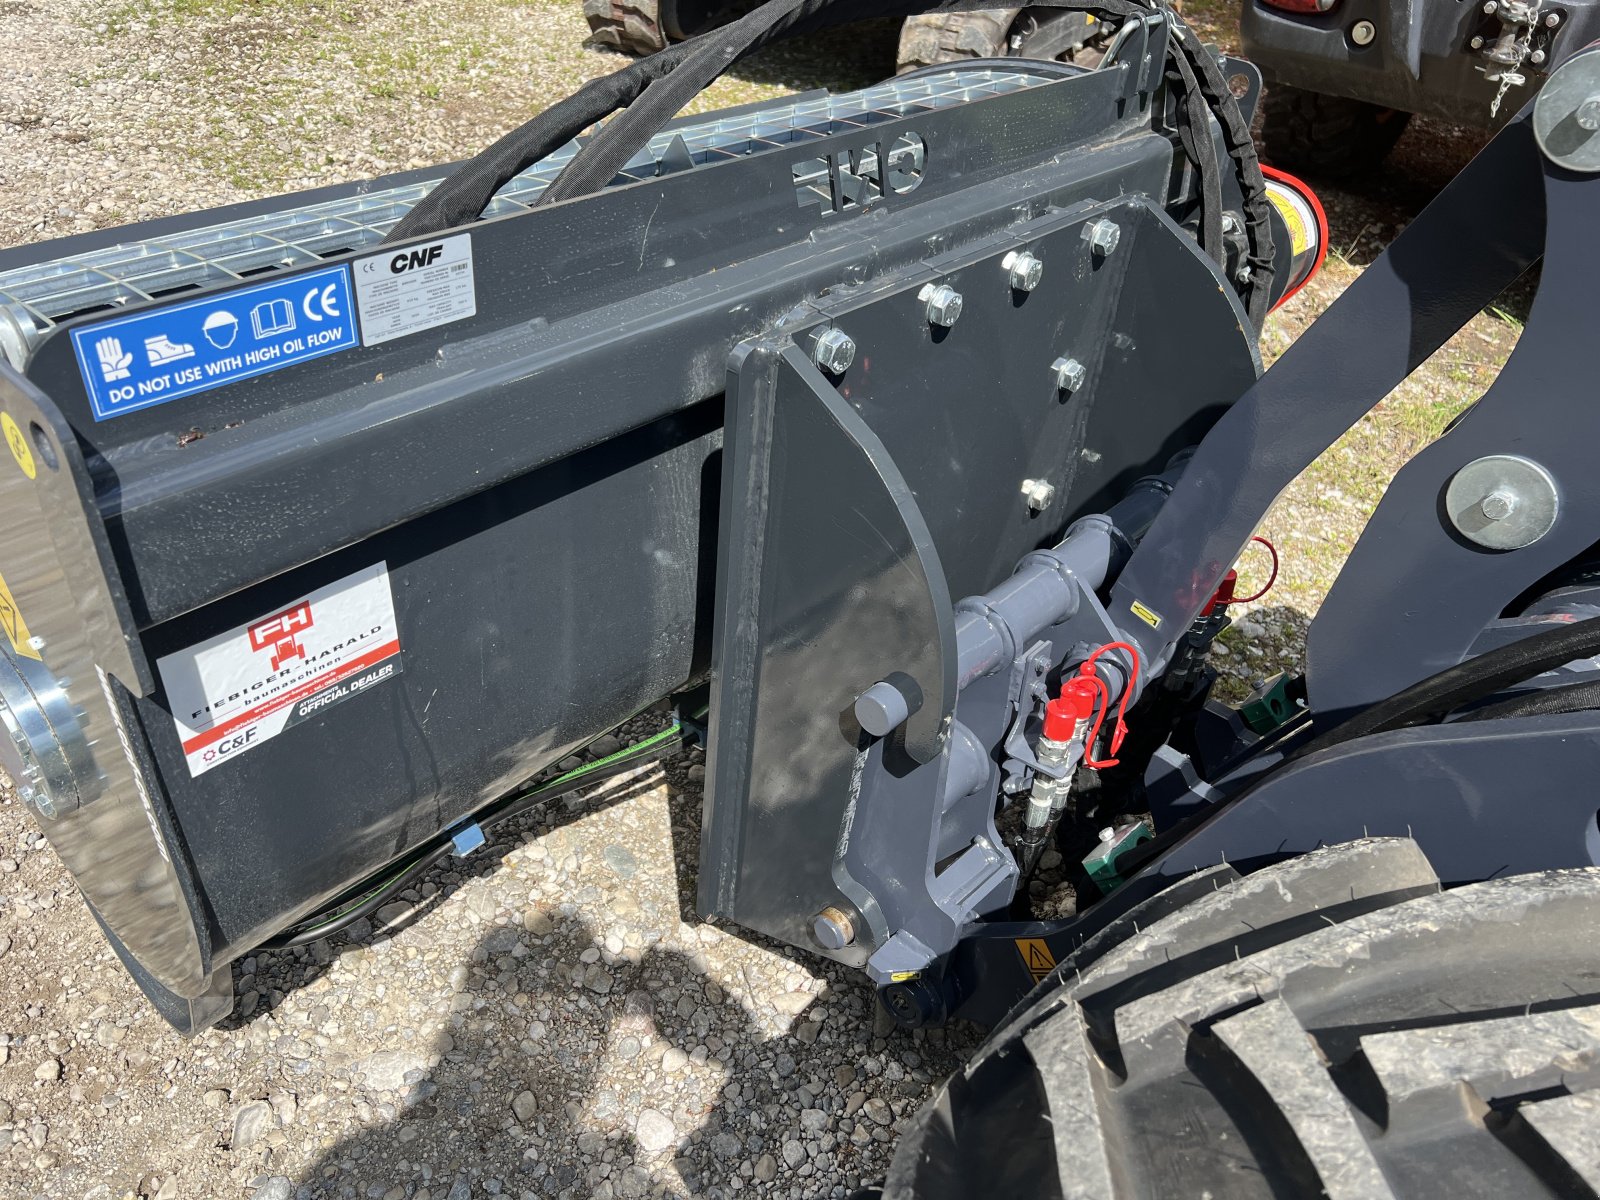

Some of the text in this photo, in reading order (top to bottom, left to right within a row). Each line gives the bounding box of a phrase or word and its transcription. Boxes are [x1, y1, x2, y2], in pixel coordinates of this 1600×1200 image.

[390, 245, 443, 274] CNF
[303, 283, 340, 321] CE
[109, 327, 342, 404] DO NOT USE WITH HIGH OIL FLOW
[254, 608, 308, 645] FH
[244, 656, 342, 706] baumaschinen
[298, 663, 393, 716] OFFICIAL DEALER
[218, 726, 258, 755] C&F
